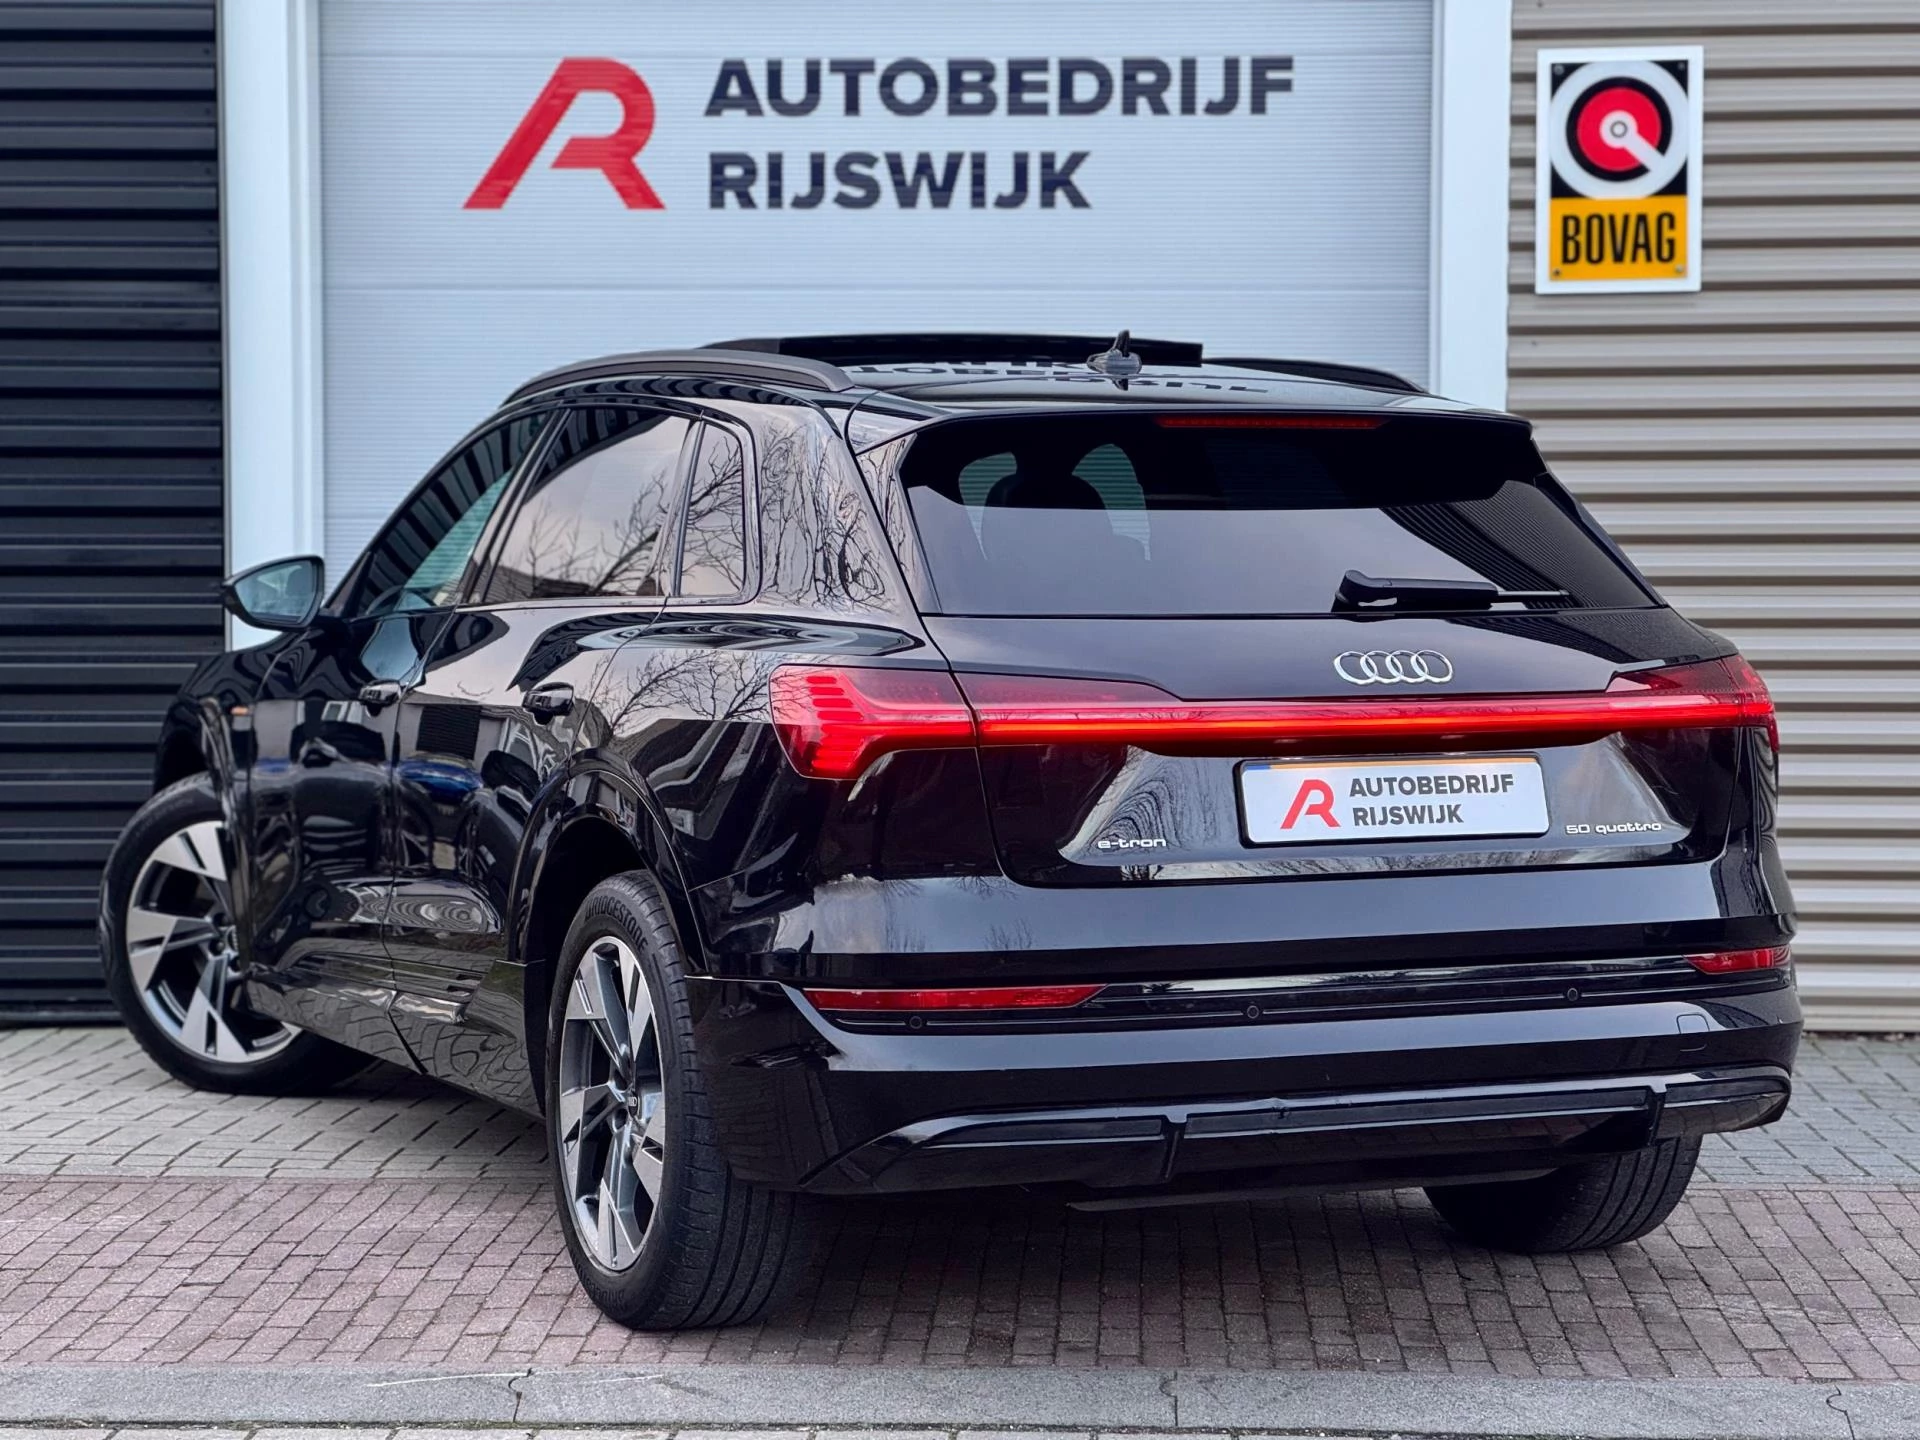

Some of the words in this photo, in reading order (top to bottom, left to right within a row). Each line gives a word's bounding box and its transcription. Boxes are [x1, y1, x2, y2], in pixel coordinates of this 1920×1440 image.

[703, 55, 1295, 118] AUTOBEDRIJF
[708, 151, 1093, 211] RIJSWIJK
[1562, 212, 1676, 265] BOVAG
[1349, 773, 1514, 798] AUTOBEDRIJF
[1352, 804, 1464, 827] RIJSWIJK
[1566, 824, 1591, 834] 50
[1595, 822, 1662, 834] quattro
[1097, 838, 1167, 849] e-tron
